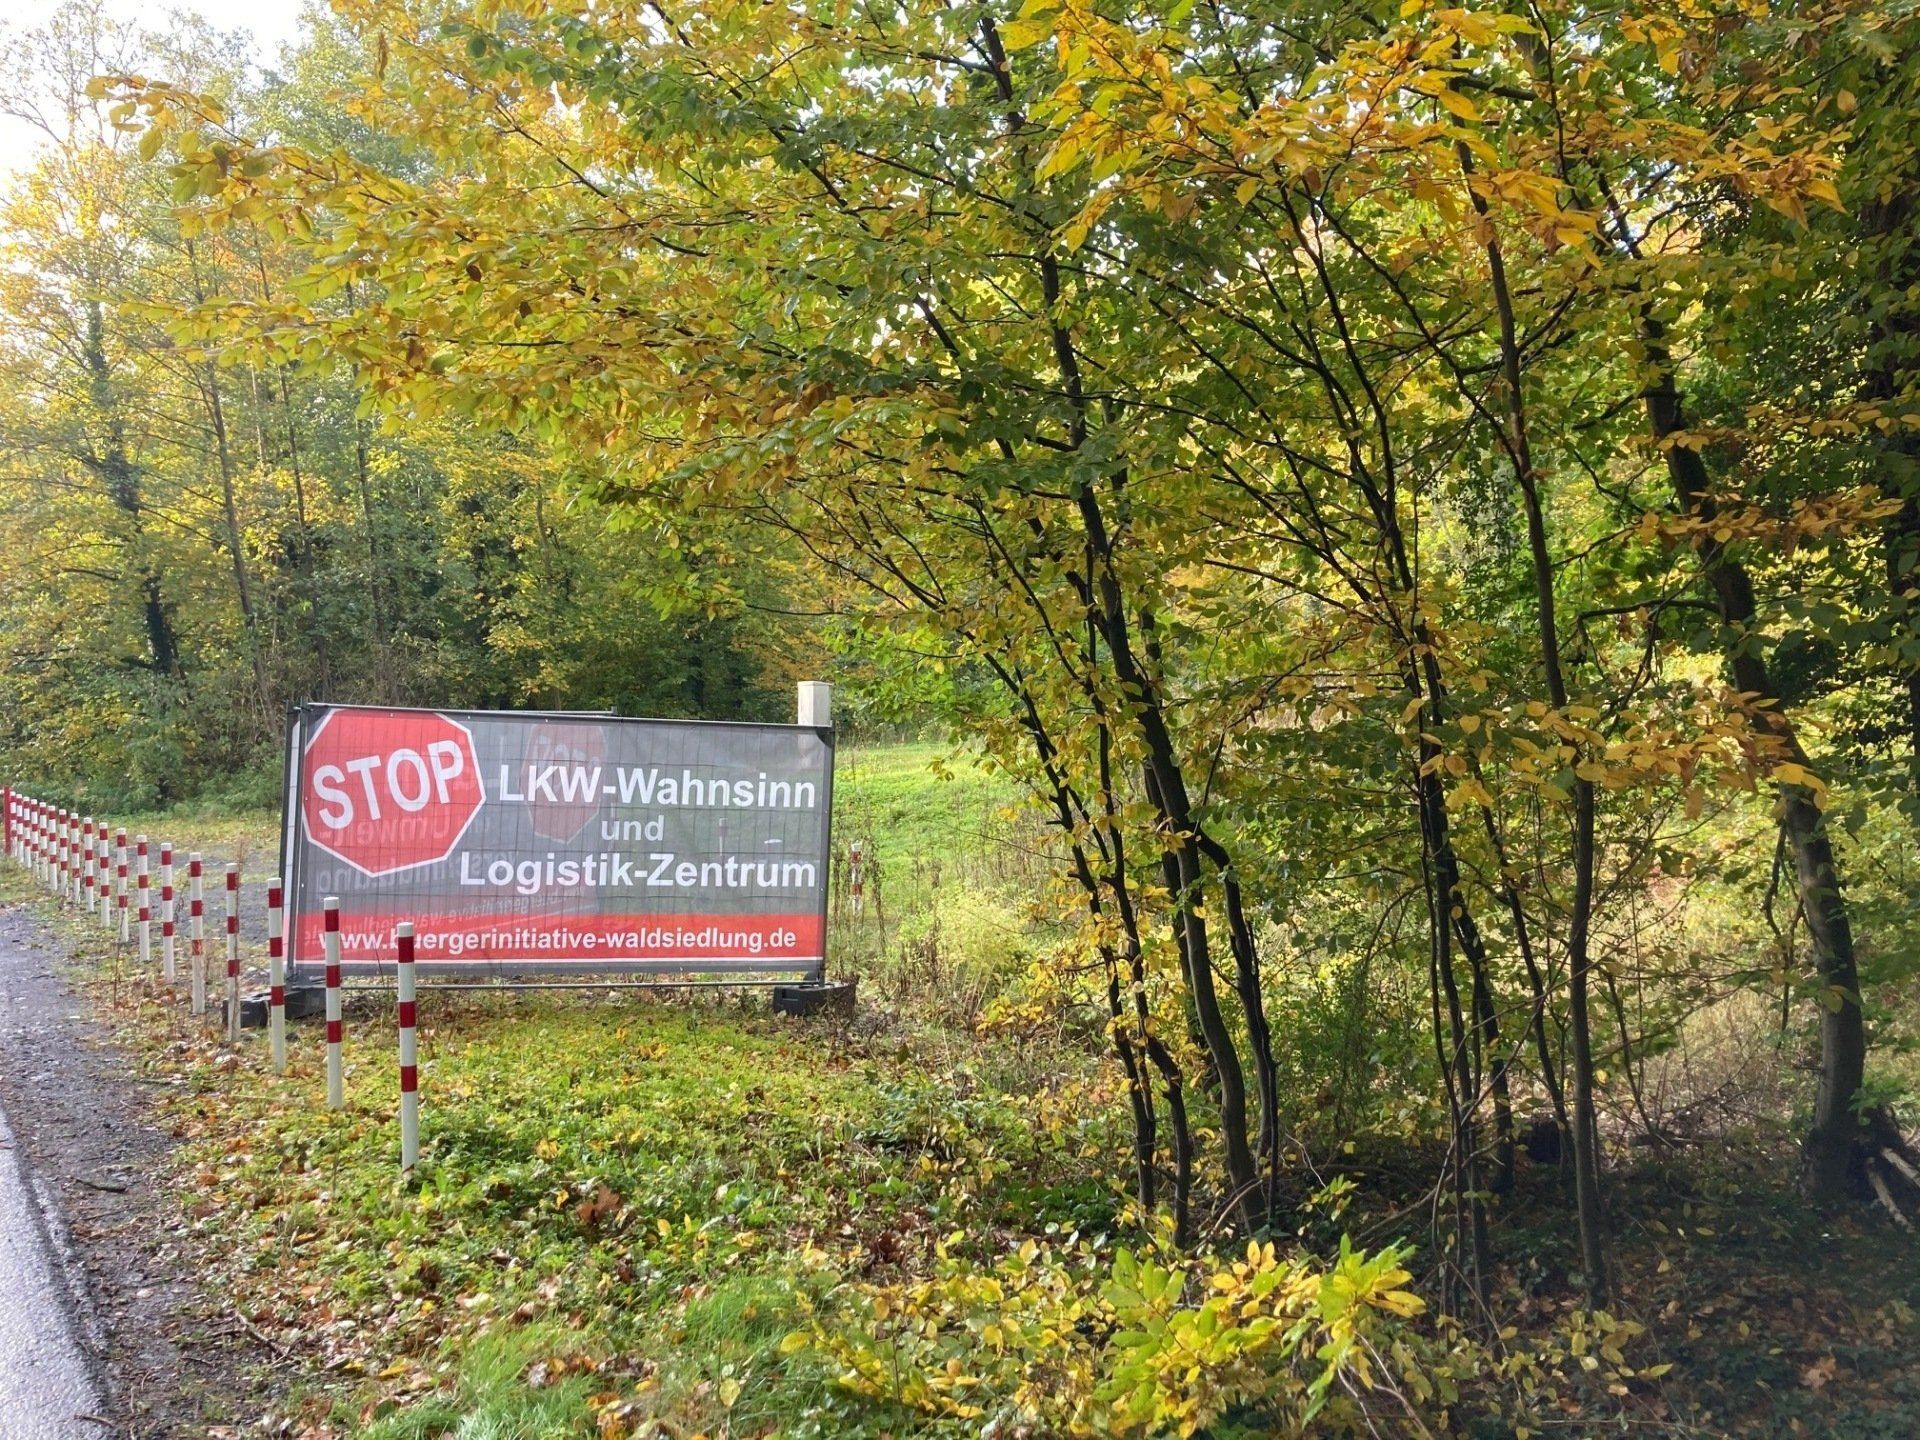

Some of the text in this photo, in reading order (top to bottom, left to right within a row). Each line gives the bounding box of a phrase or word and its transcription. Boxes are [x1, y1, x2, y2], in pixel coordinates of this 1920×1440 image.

[312, 740, 464, 830] STOP
[499, 764, 815, 808] LKW-Wahnsinn
[601, 815, 665, 842] und
[460, 851, 815, 895] Logistik-Zentrum
